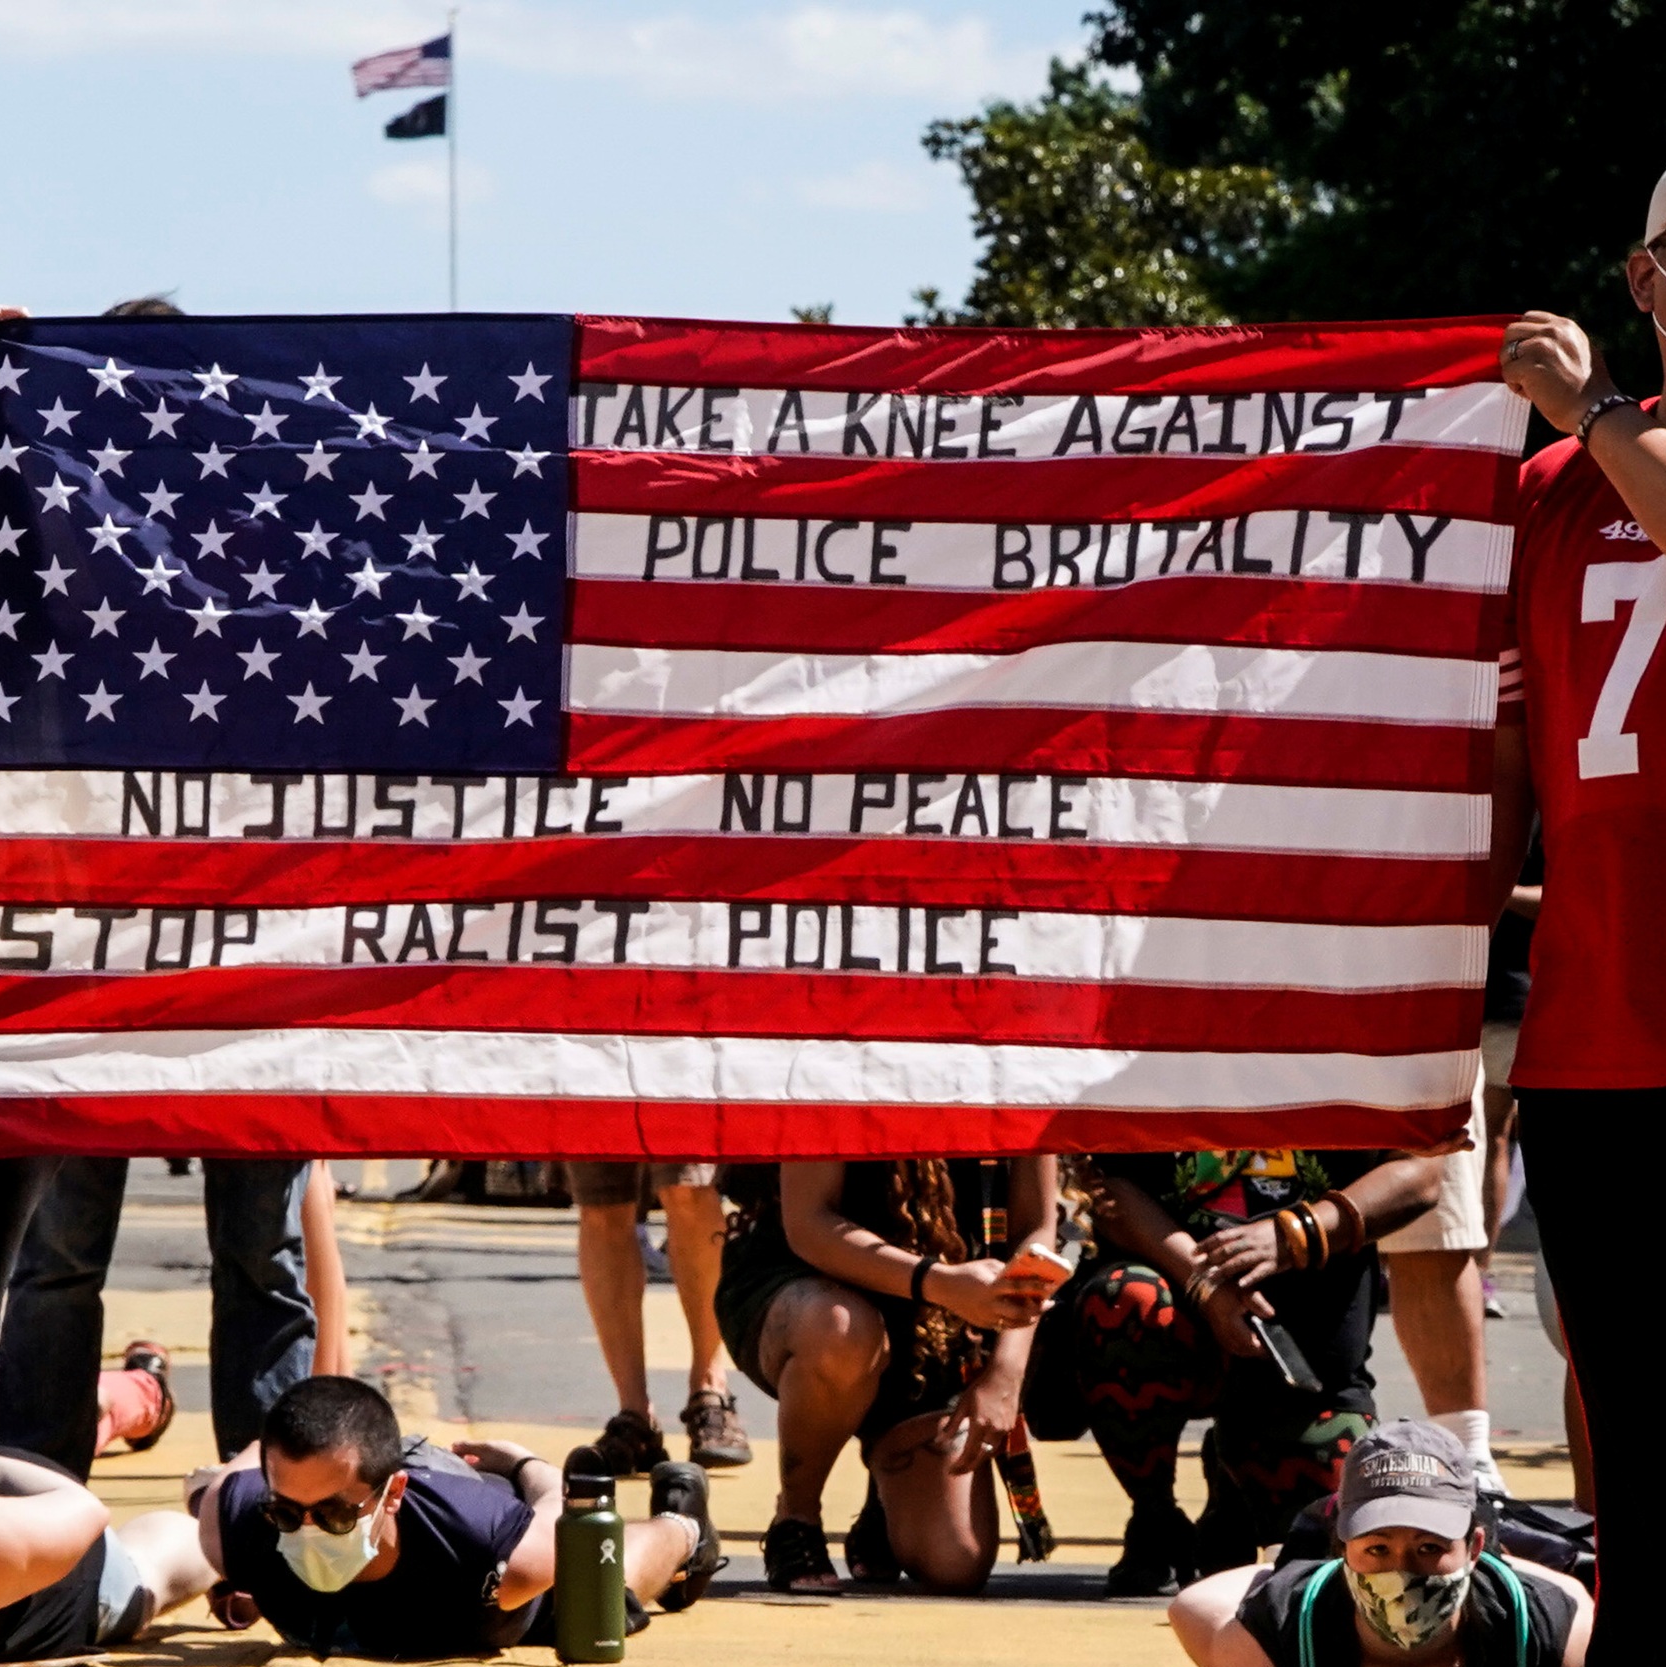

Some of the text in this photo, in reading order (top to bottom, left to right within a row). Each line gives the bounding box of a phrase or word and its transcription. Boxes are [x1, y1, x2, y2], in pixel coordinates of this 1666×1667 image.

[577, 383, 1426, 459] TAKE A KNEE AGAINST
[642, 511, 1451, 589] POLICE BRUTALITY
[122, 771, 1088, 839] NO JUSTICE NO PEACE
[343, 900, 649, 963] RACIST
[731, 902, 1019, 974] POLICE
[1363, 1452, 1438, 1478] SMITHSONIAN
